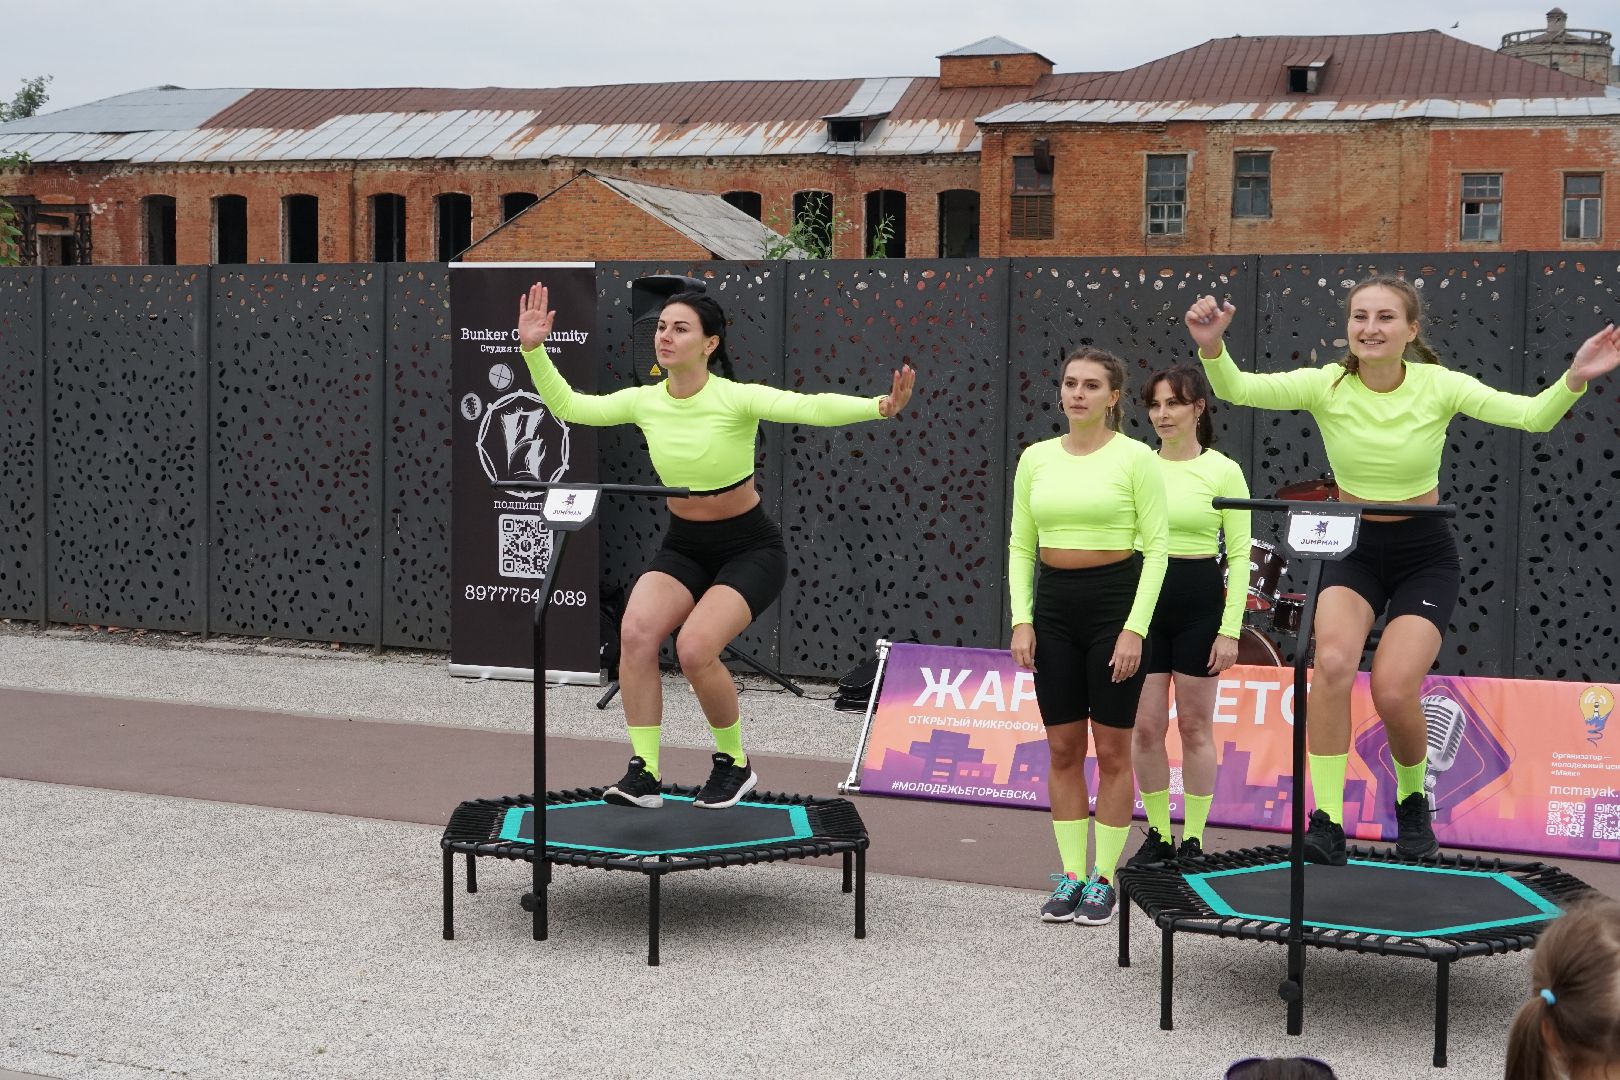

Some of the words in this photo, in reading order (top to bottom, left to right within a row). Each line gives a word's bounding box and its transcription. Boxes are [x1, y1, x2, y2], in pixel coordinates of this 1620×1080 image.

[460, 328, 508, 341] Bunker
[511, 329, 589, 344] Cunity
[480, 344, 512, 354] Студия
[1300, 538, 1339, 546] JUMPMAN
[464, 584, 587, 607] 8977754089
[908, 715, 970, 728] ОТКРЫТЫЙ
[972, 718, 1039, 731] МИКРОФОН
[891, 780, 1037, 801] #МОЛОДЕЖЬЕГОРЬЕВСКА
